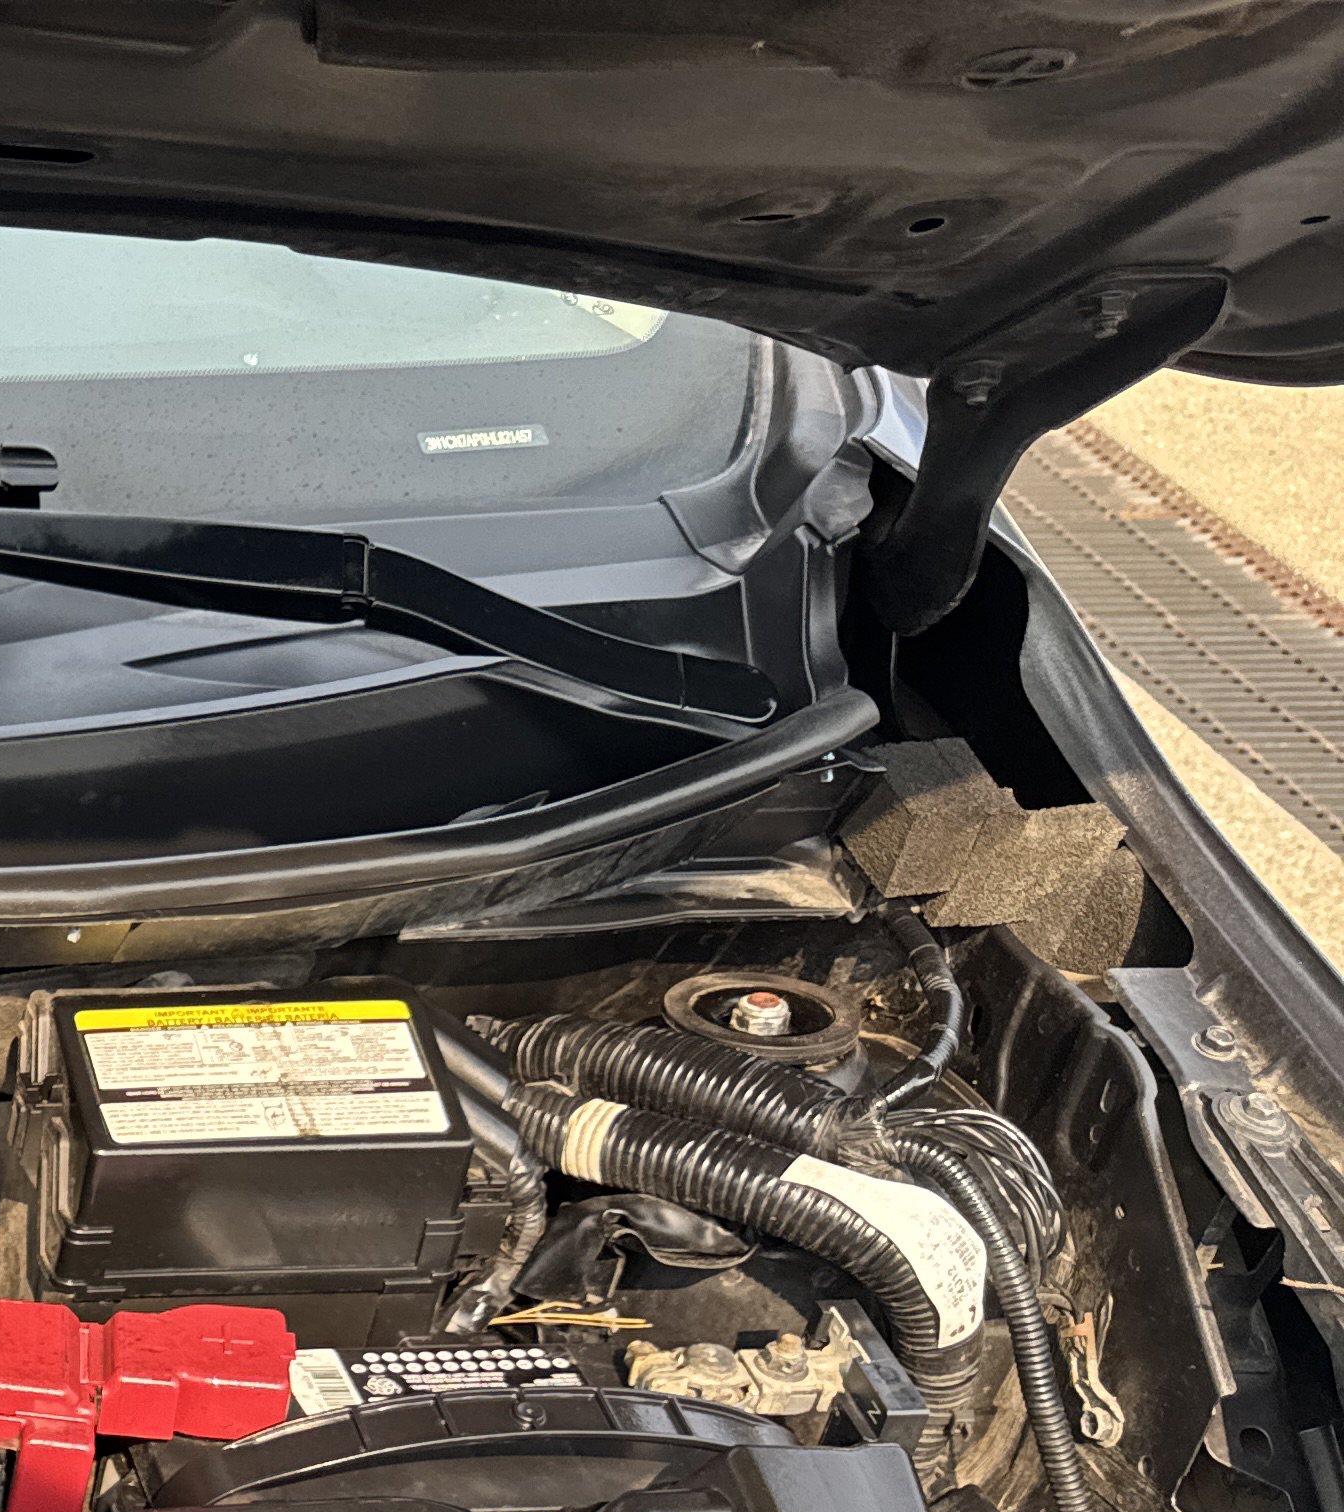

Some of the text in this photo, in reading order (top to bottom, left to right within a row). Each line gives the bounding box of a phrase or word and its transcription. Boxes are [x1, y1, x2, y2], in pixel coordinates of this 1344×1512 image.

[154, 1005, 326, 1018] IMPORTANT IMPORTANTE
[147, 1017, 204, 1027] BATTERY
